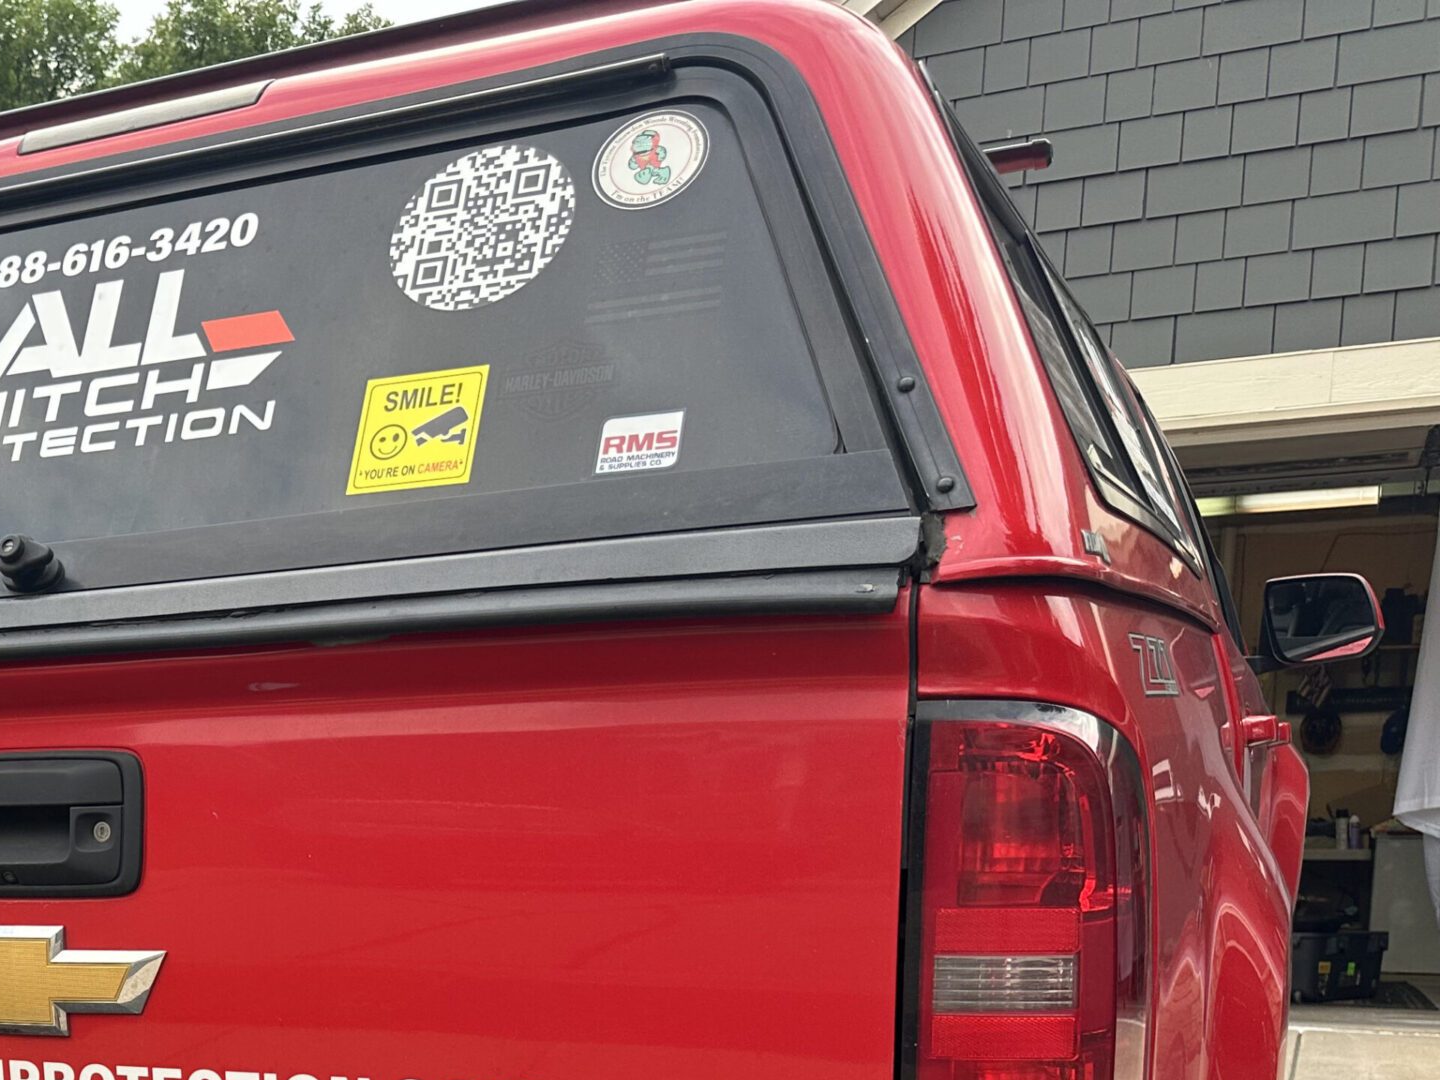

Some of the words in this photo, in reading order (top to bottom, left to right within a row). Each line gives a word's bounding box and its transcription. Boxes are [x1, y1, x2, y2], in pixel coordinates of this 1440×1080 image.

[505, 364, 615, 393] HARLEY-DAVIDSON
[384, 382, 463, 412] SMILE!
[602, 430, 678, 455] RMS
[600, 455, 624, 464] ROAD
[626, 450, 676, 462] MACHINERY
[608, 461, 647, 470] SUPPLIES
[401, 465, 416, 476] ON
